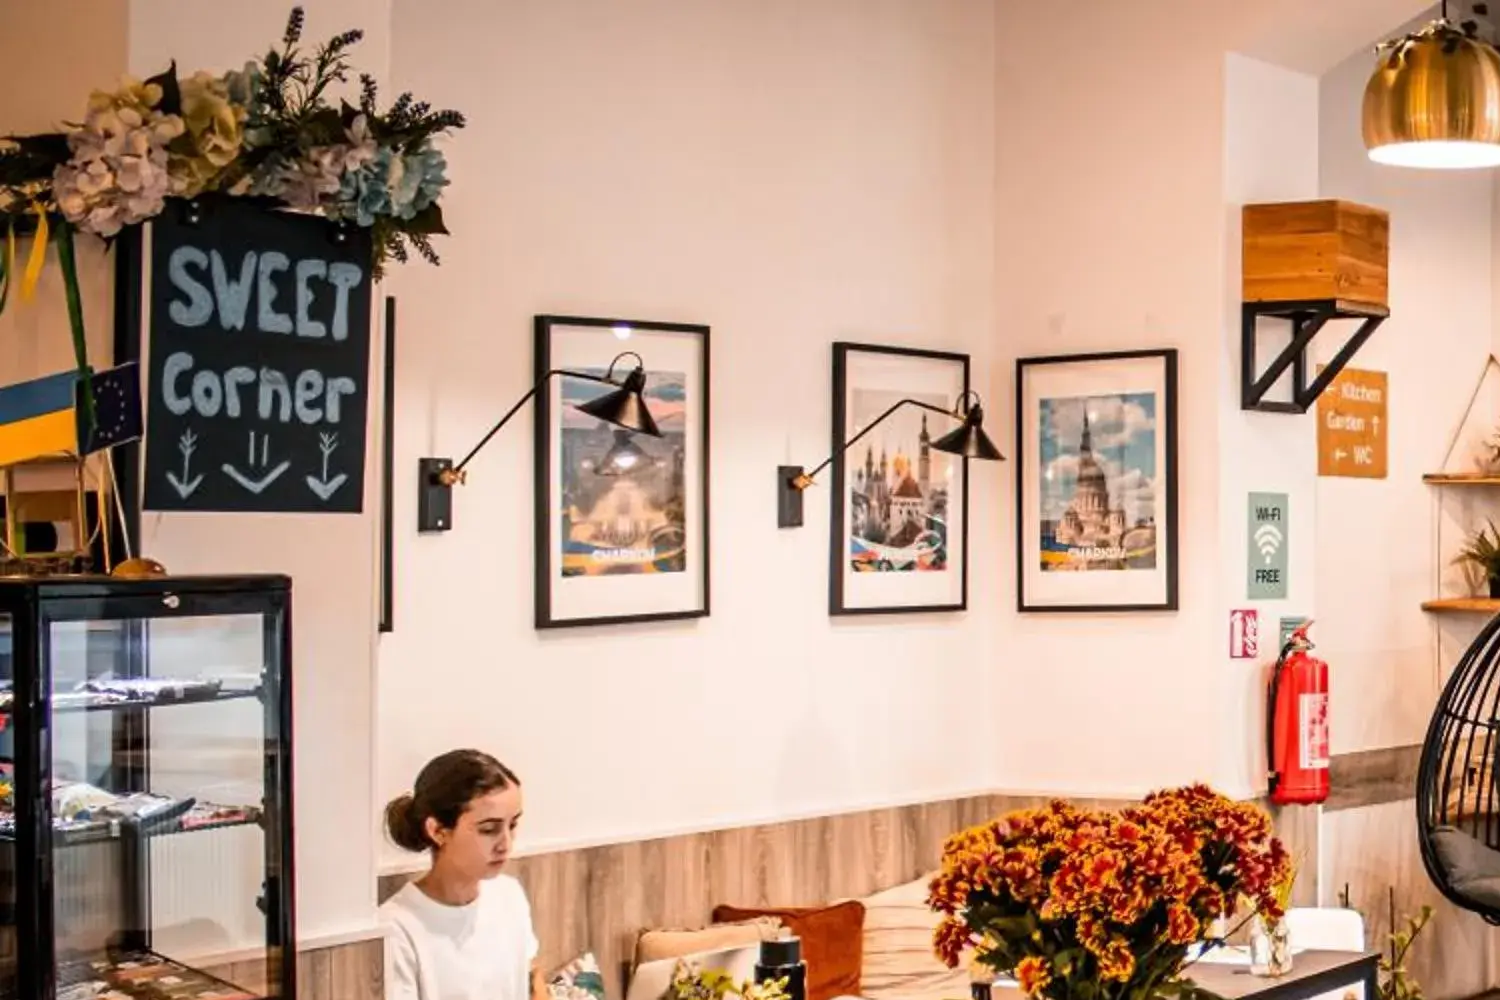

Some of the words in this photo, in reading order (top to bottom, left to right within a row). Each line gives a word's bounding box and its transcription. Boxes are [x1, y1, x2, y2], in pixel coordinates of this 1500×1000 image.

[169, 245, 363, 341] SWEET
[162, 351, 357, 425] Corner
[1341, 382, 1382, 403] Kitchen
[1326, 409, 1366, 432] Garden
[1353, 445, 1374, 465] WC
[1255, 506, 1281, 521] WI-FI
[1255, 569, 1281, 583] FREE
